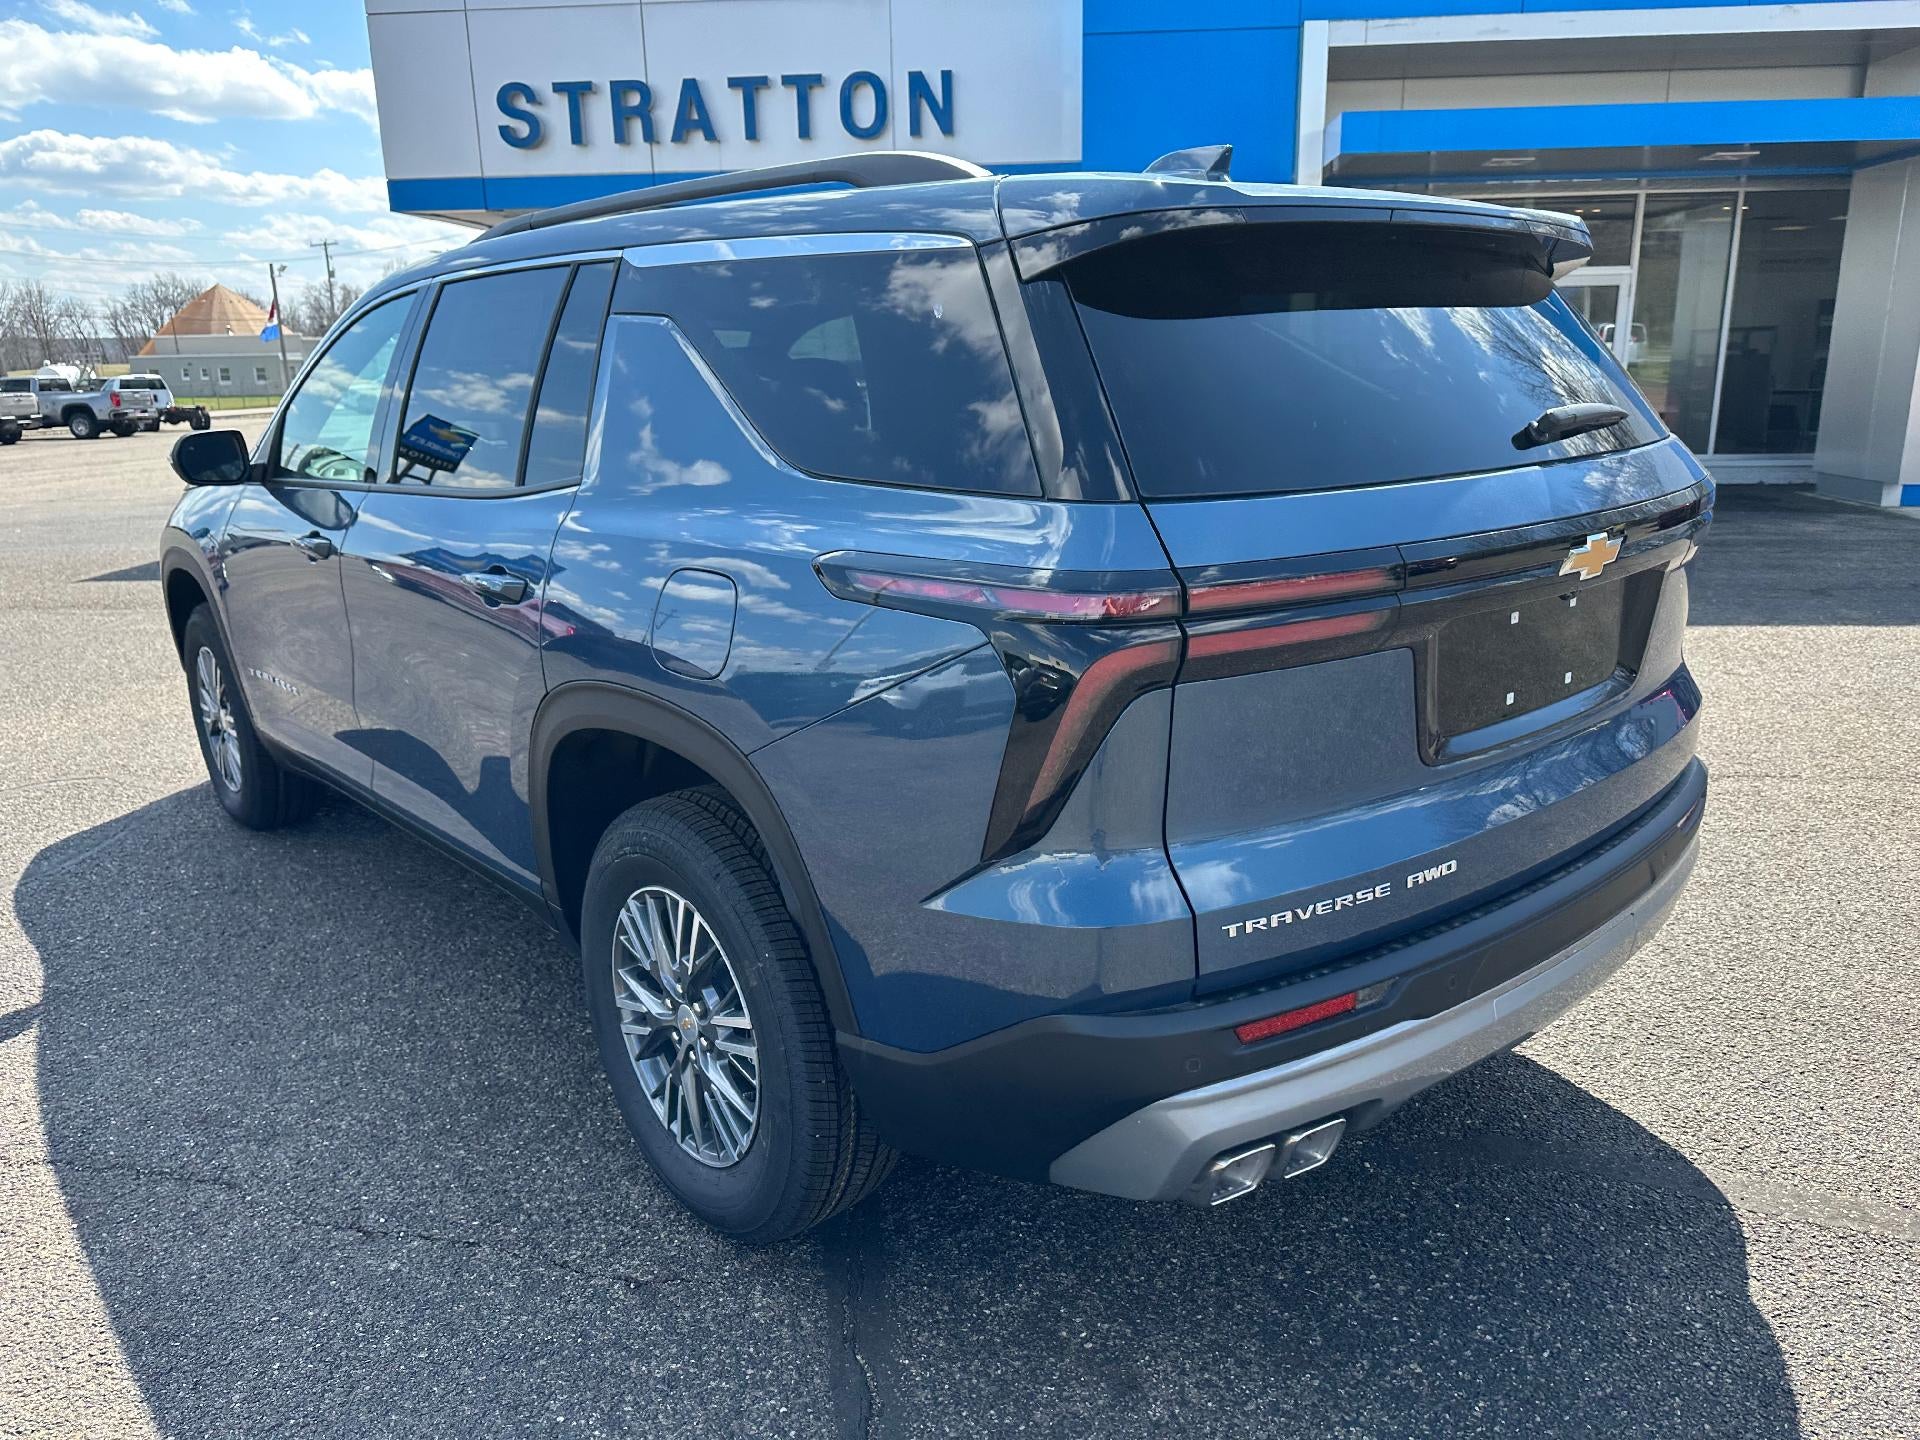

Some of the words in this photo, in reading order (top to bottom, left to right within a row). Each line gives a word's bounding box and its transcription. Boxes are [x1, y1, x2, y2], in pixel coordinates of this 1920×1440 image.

[496, 70, 954, 149] STRATTON
[1221, 882, 1391, 938] TRAVERSE
[1406, 859, 1457, 889] AWD
